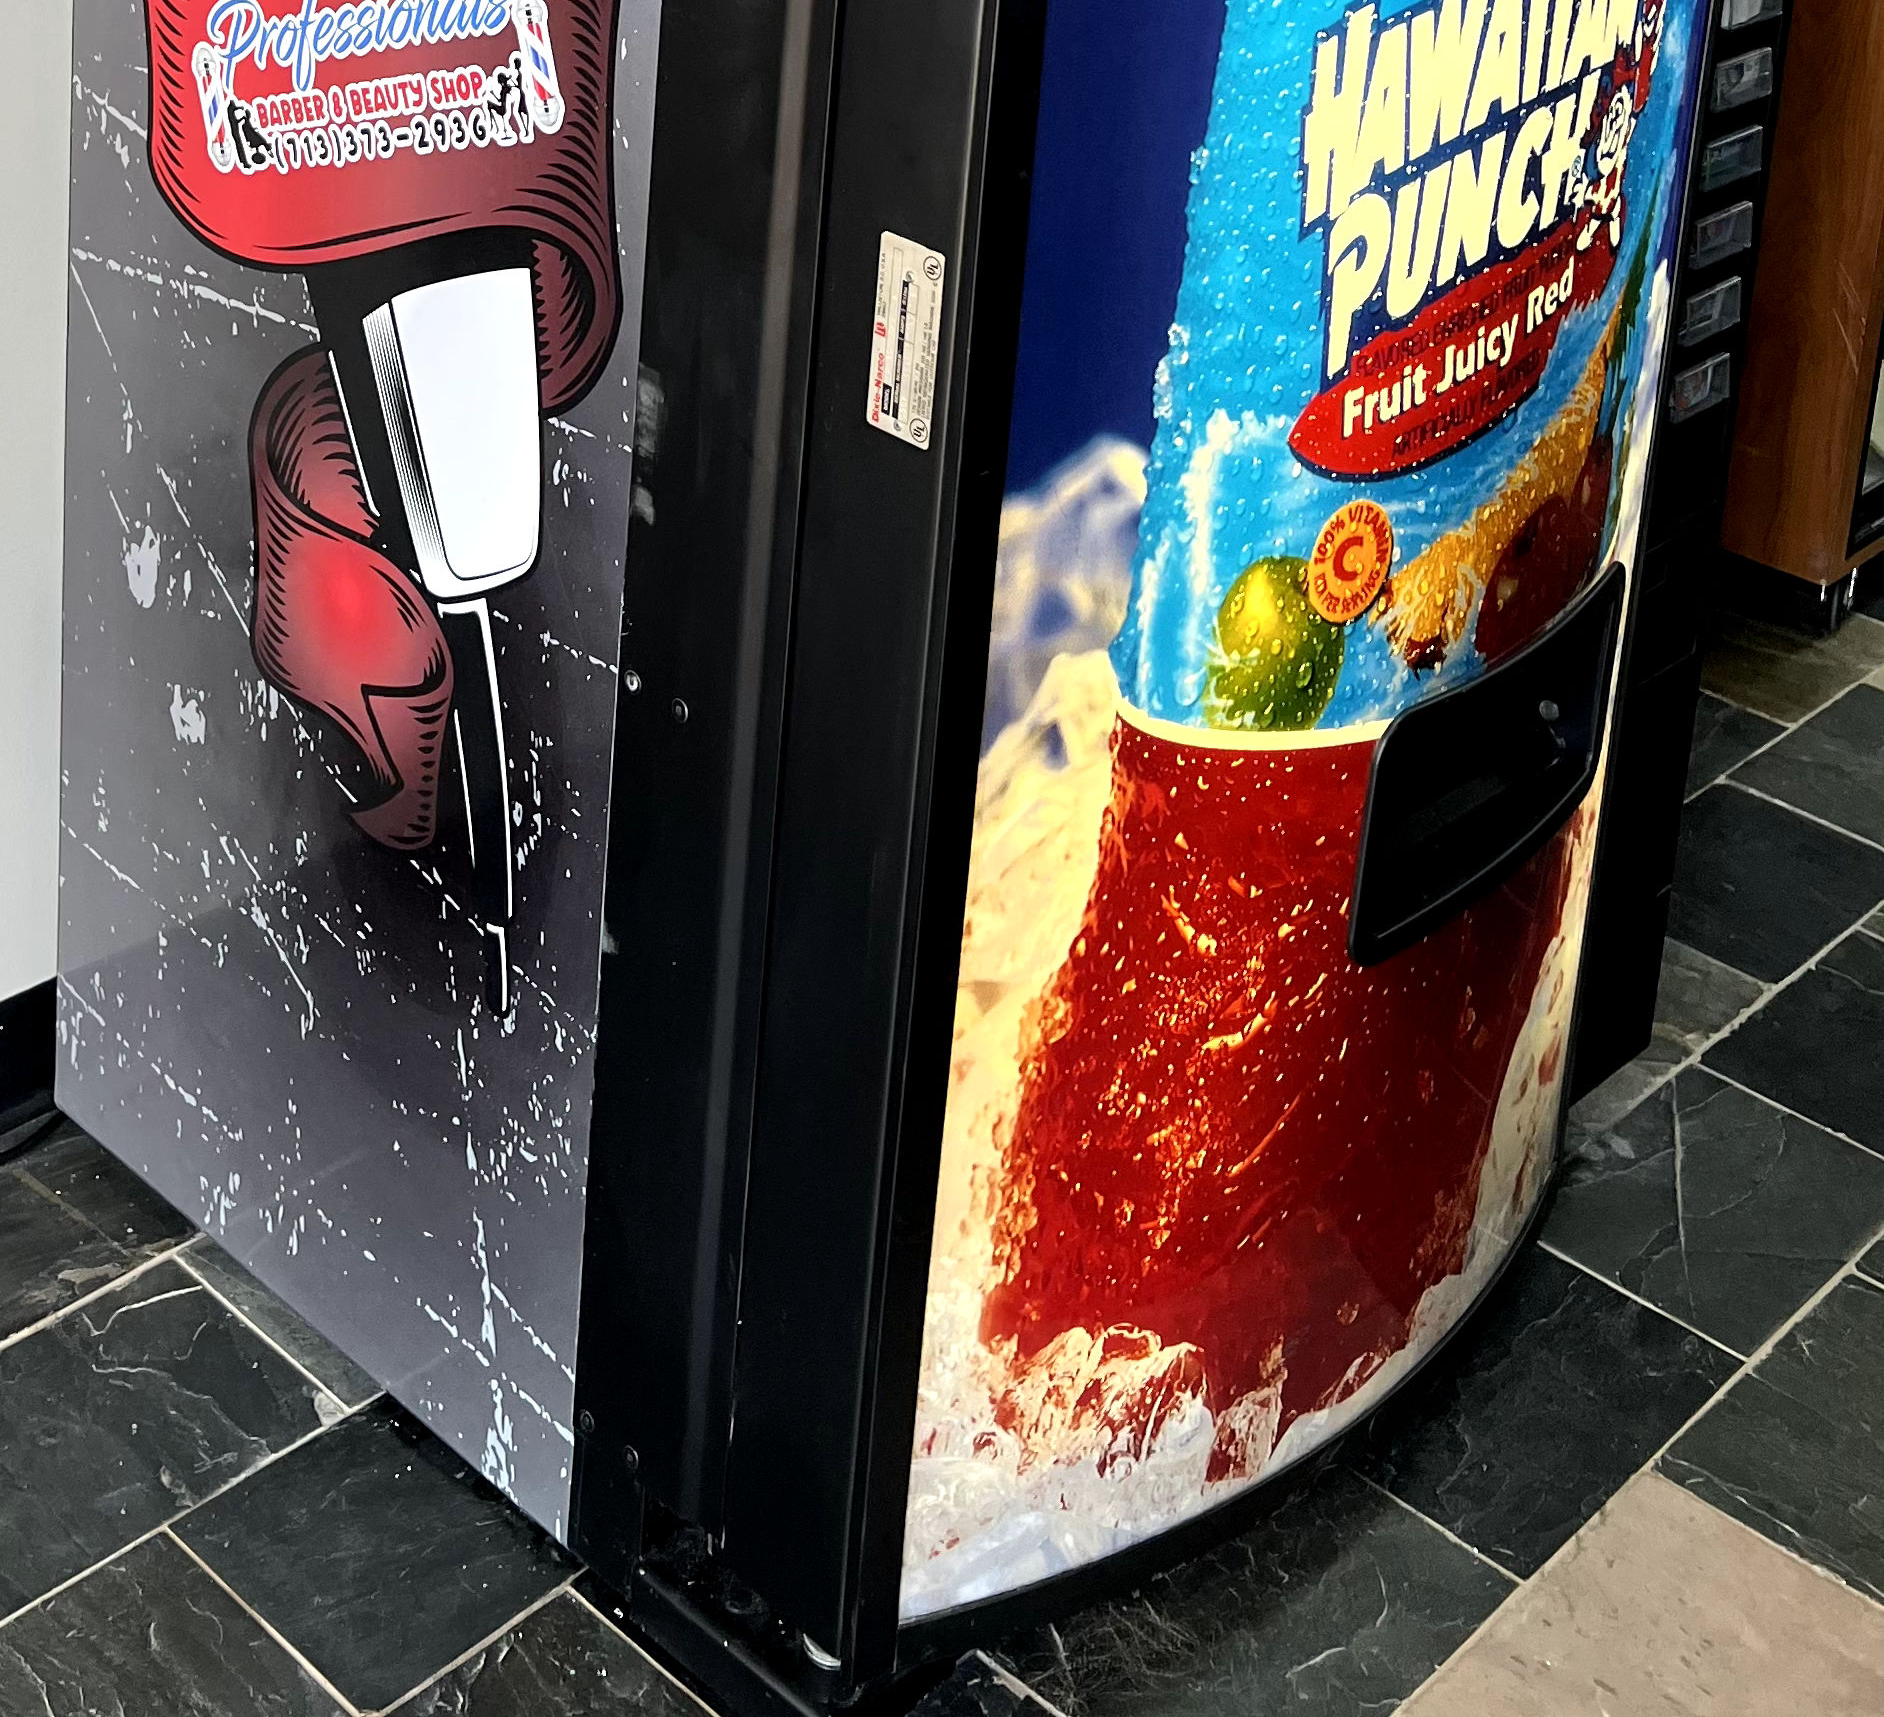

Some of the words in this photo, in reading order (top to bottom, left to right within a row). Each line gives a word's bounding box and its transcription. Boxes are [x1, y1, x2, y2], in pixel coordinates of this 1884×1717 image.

[256, 95, 324, 126] BARBER
[350, 81, 422, 114] BEAUTY
[433, 71, 484, 104] SHOP
[274, 116, 488, 169] (713)373-2936
[1329, 71, 1600, 378] PUNCH
[1342, 363, 1427, 438] Fruit
[1436, 313, 1520, 394] Juicy
[1526, 255, 1575, 334] Red
[871, 352, 885, 423] Dixie-Narco
[1314, 515, 1346, 565] 100%
[1332, 535, 1364, 581] C
